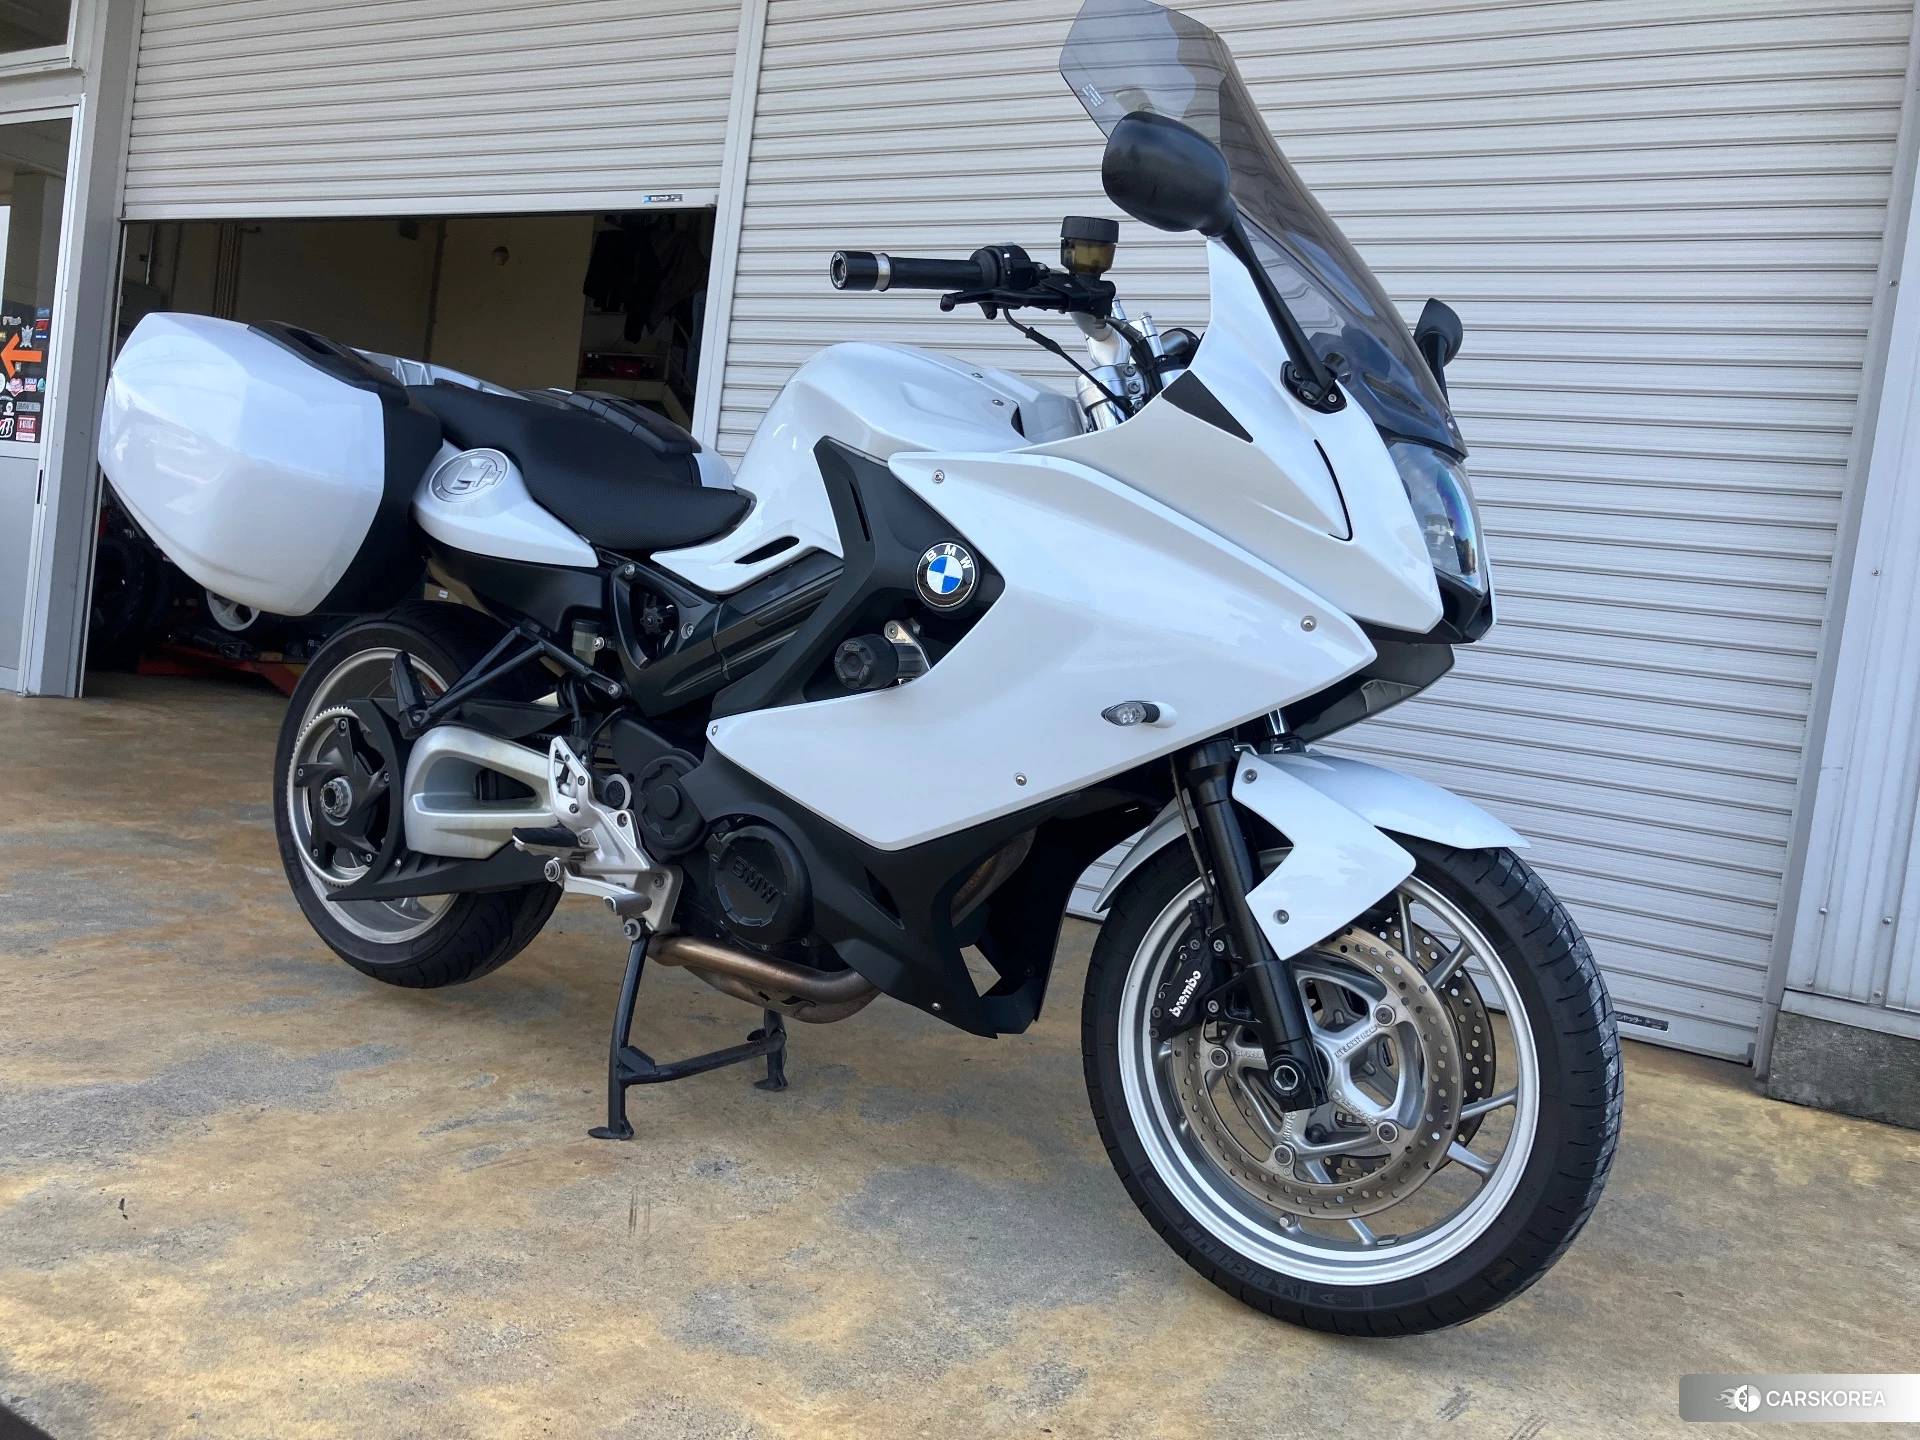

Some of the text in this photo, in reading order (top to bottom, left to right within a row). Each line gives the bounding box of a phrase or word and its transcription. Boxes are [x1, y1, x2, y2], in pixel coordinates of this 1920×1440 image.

[926, 545, 972, 569] BMW
[731, 855, 779, 904] BMW
[1168, 970, 1201, 1018] brembo
